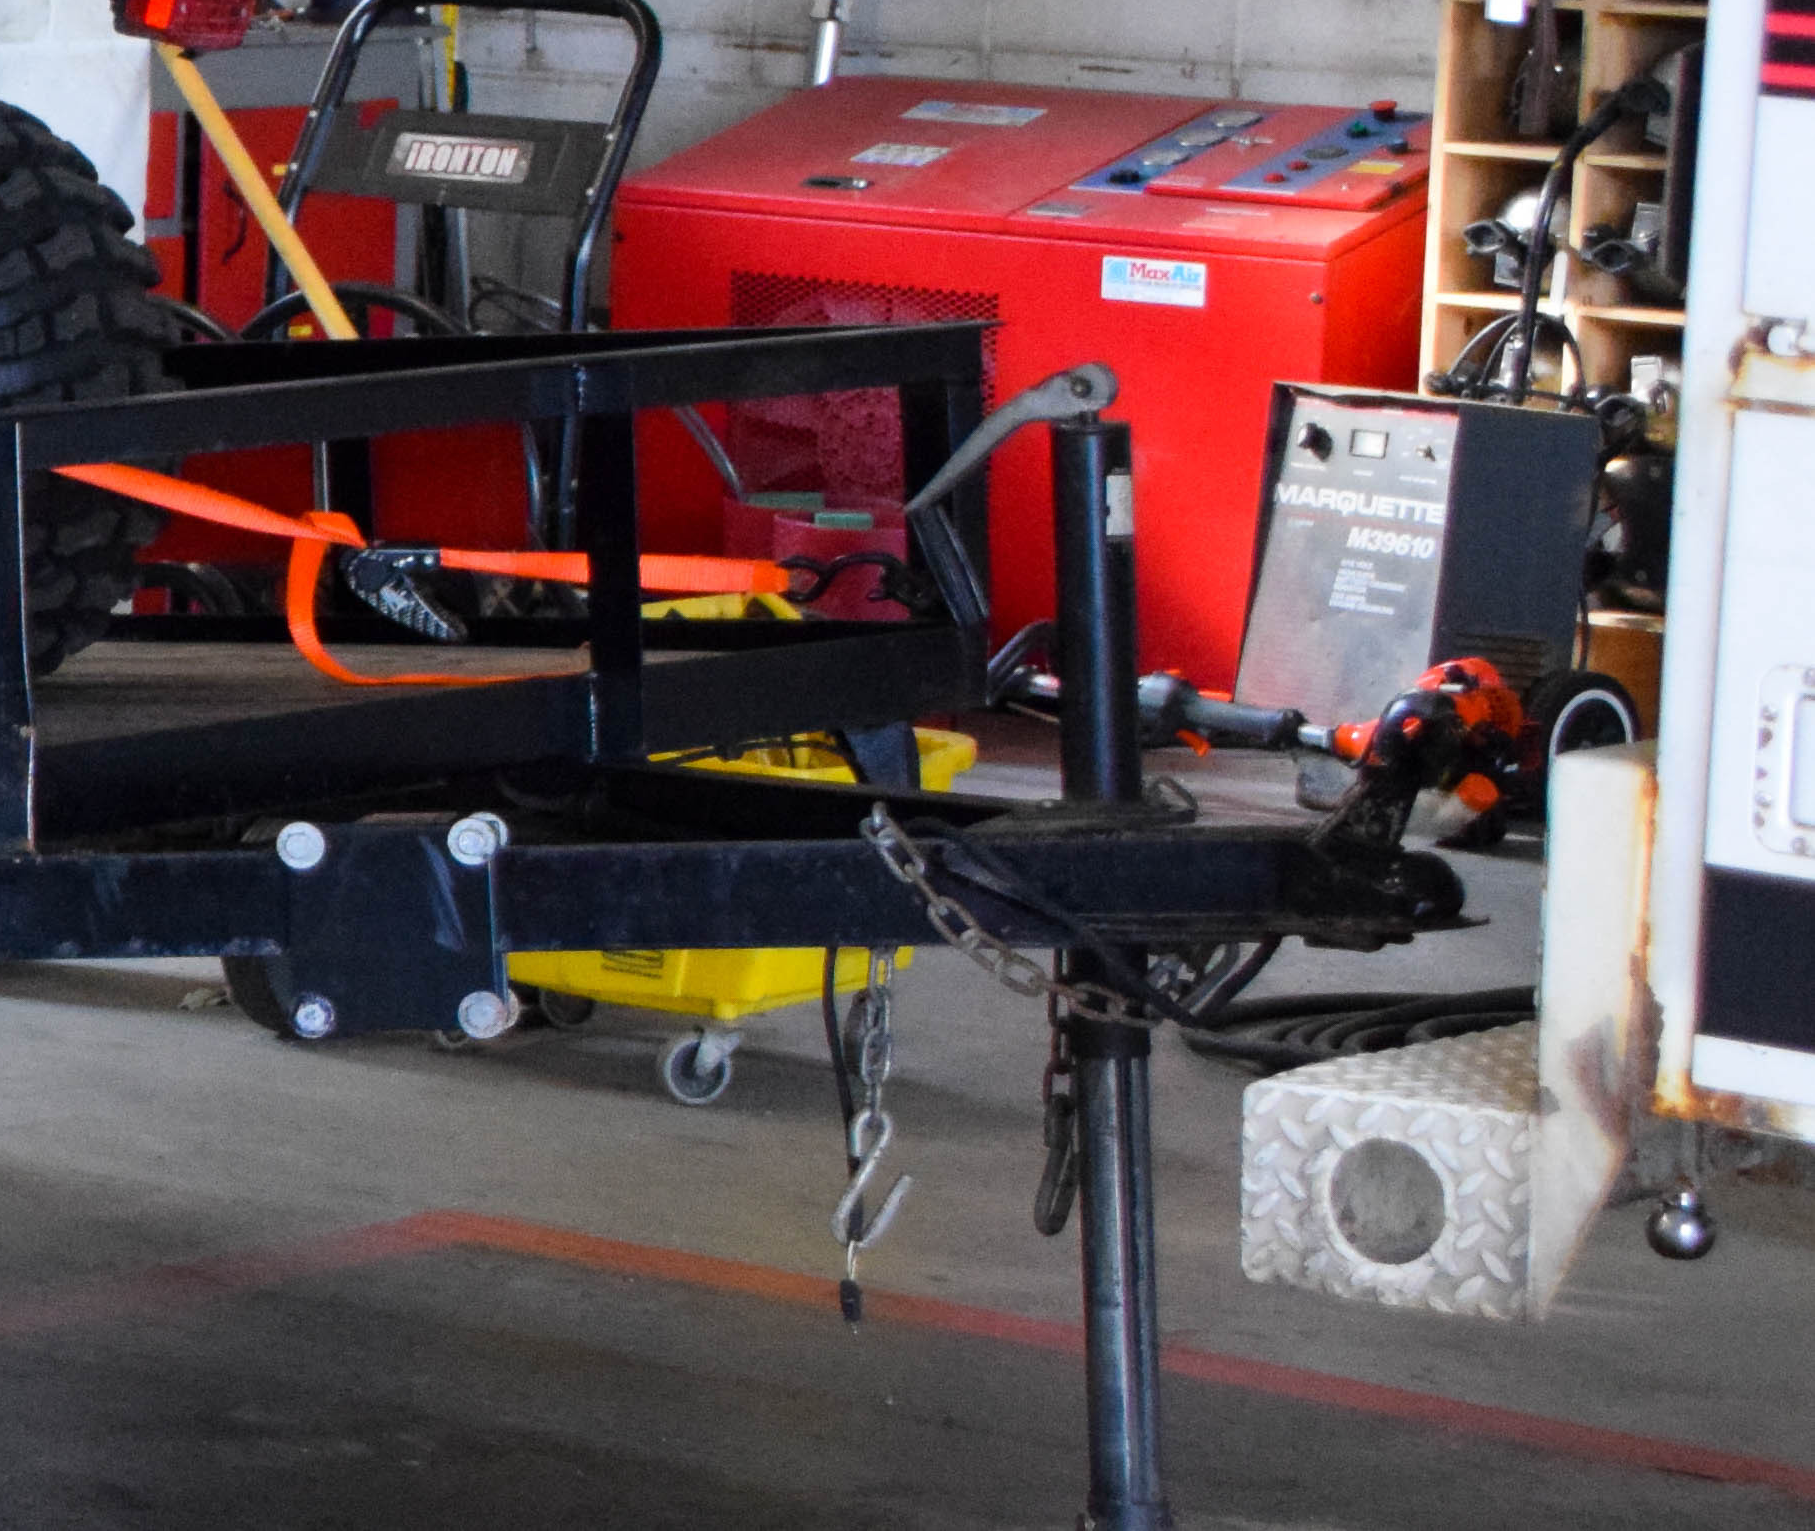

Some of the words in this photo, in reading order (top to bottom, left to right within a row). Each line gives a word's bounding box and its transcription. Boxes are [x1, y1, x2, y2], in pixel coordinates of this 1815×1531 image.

[404, 140, 519, 176] IRONTON
[1277, 482, 1445, 526] MARQUETTE
[1346, 526, 1436, 559] M39610
